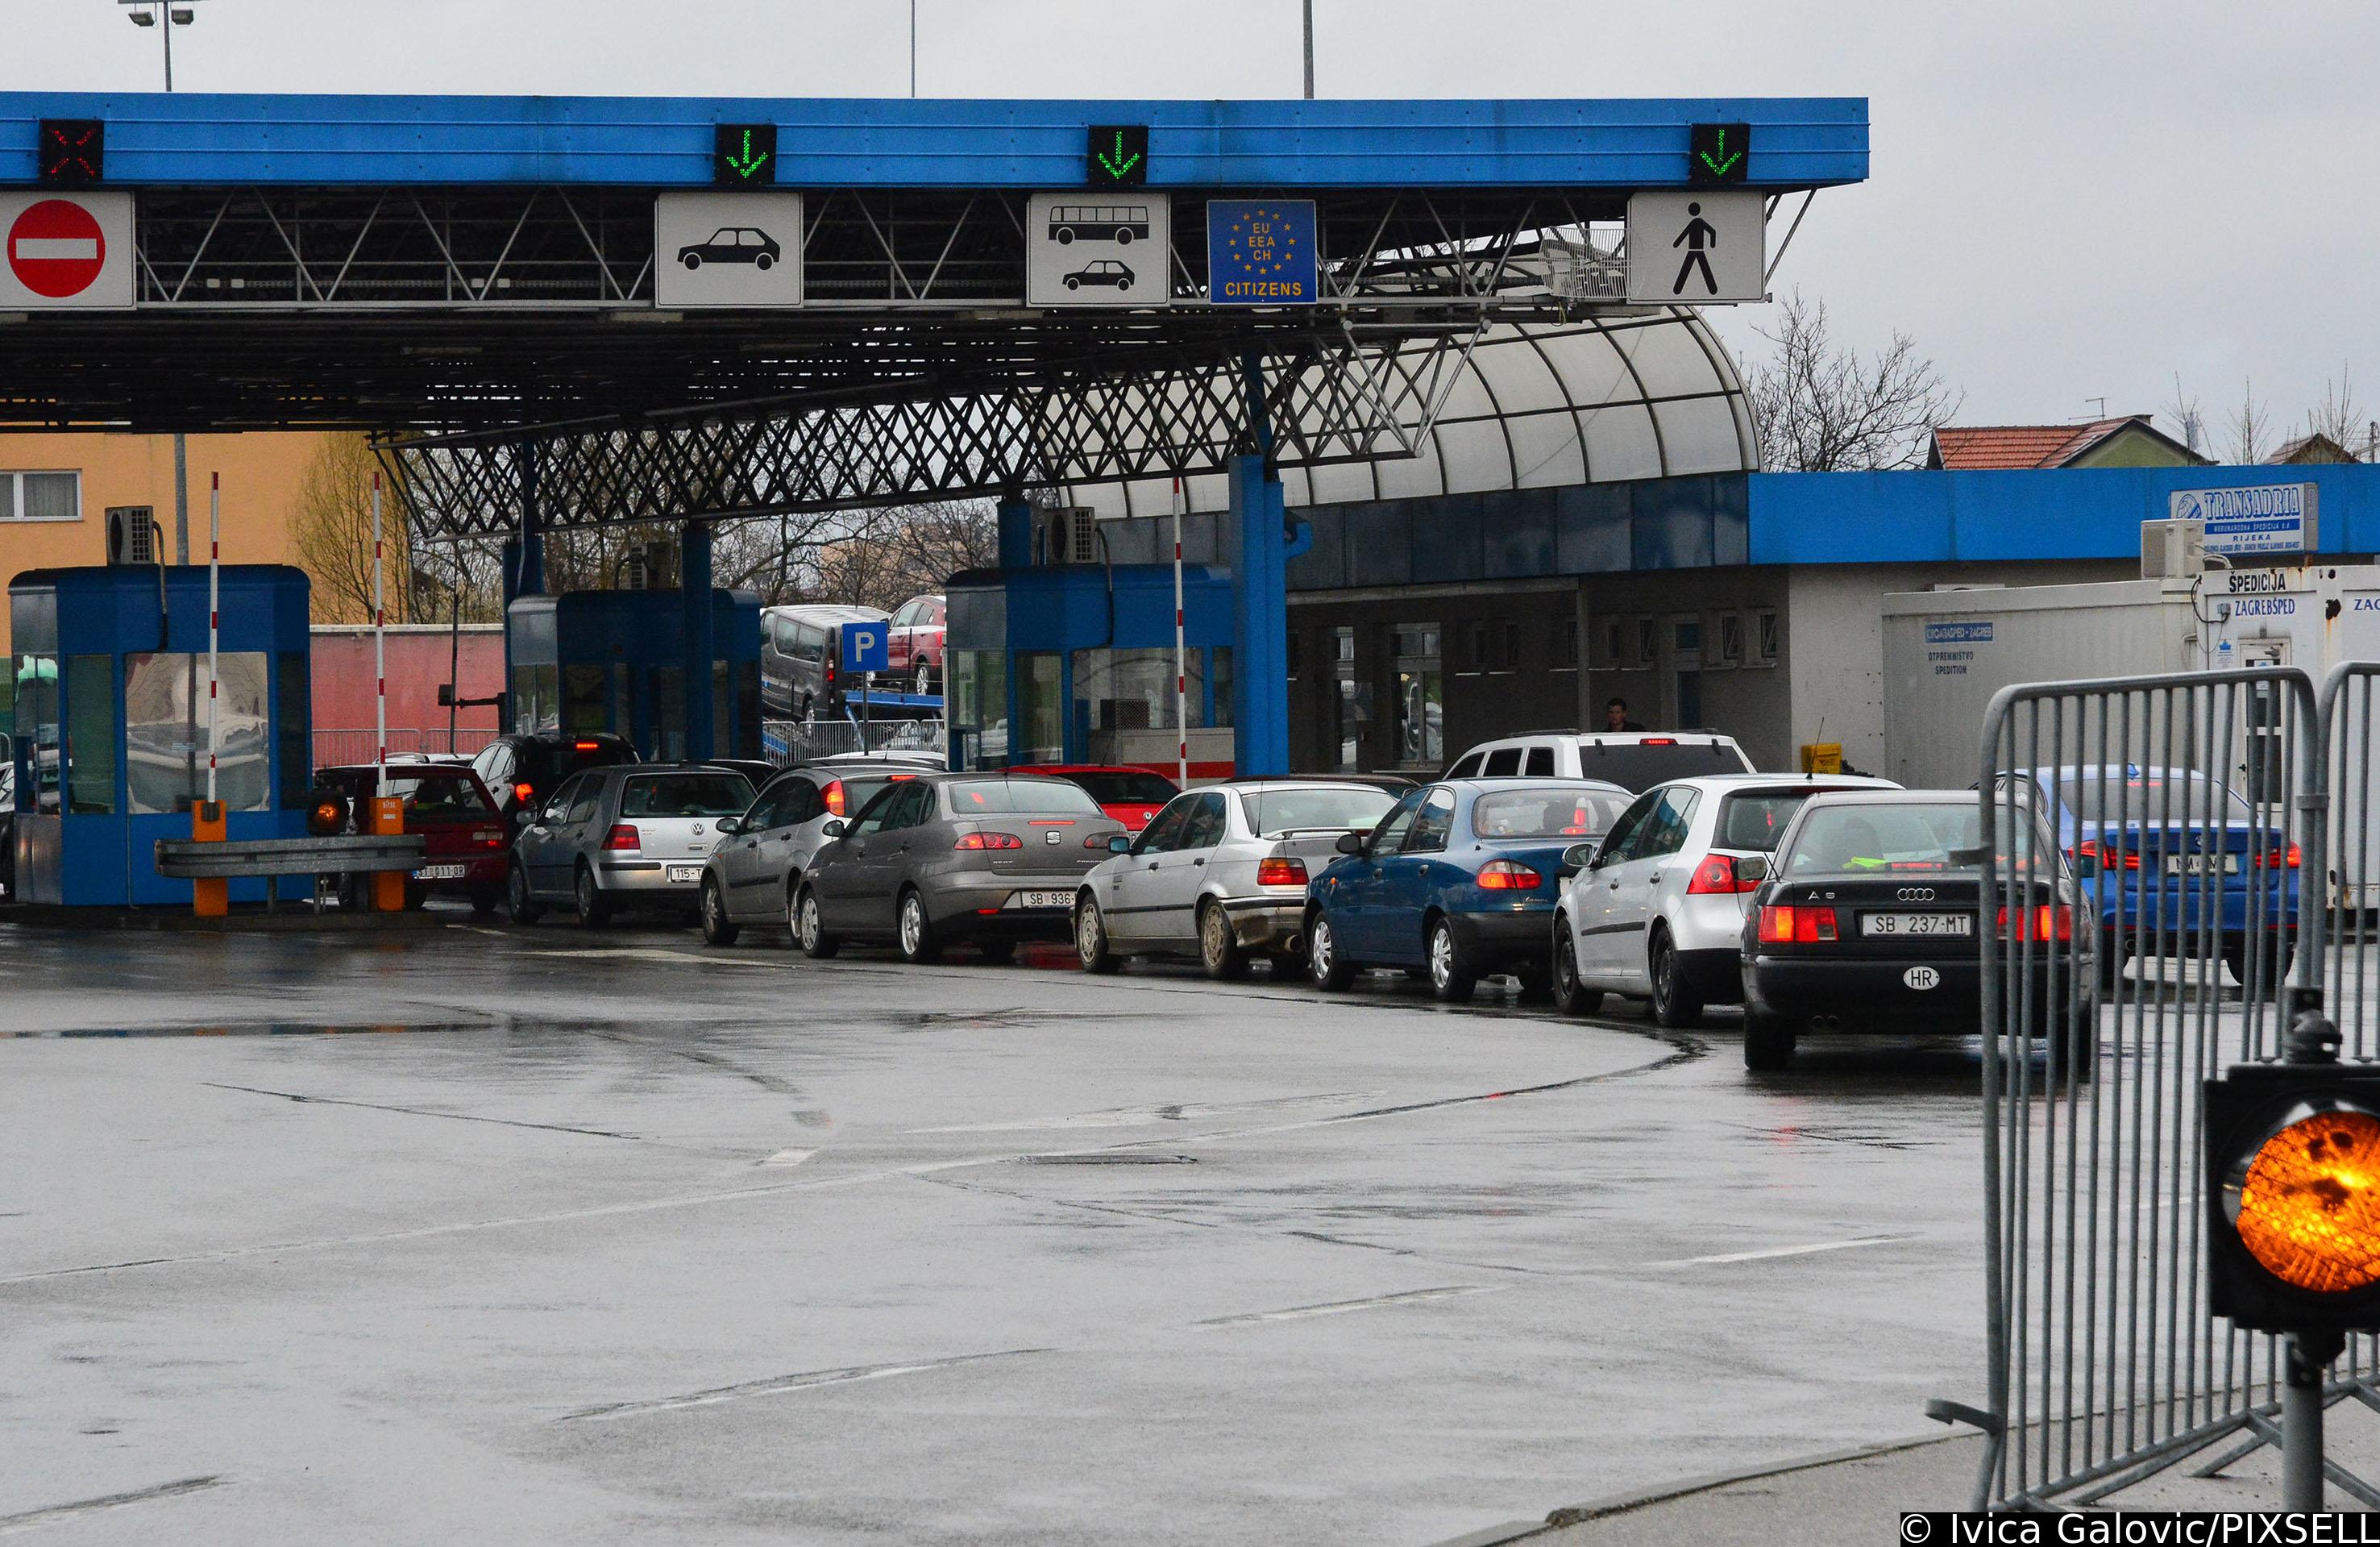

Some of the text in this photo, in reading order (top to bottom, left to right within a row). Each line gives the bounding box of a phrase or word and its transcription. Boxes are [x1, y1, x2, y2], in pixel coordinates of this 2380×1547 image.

[1252, 222, 1270, 234] EU
[1248, 236, 1276, 247] EEA
[1253, 250, 1271, 261] CH
[1225, 282, 1302, 296] CITIZENS
[2204, 487, 2300, 521] TRANSADRIA
[2233, 534, 2271, 543] RIJEKA
[2229, 570, 2287, 593] ŠPEDICIJA
[2235, 597, 2295, 617] ZAGREBŠPED
[855, 631, 875, 663] P
[1030, 892, 1076, 904] SB 936-
[1875, 916, 1896, 933] SB
[1910, 970, 1933, 986] HR
